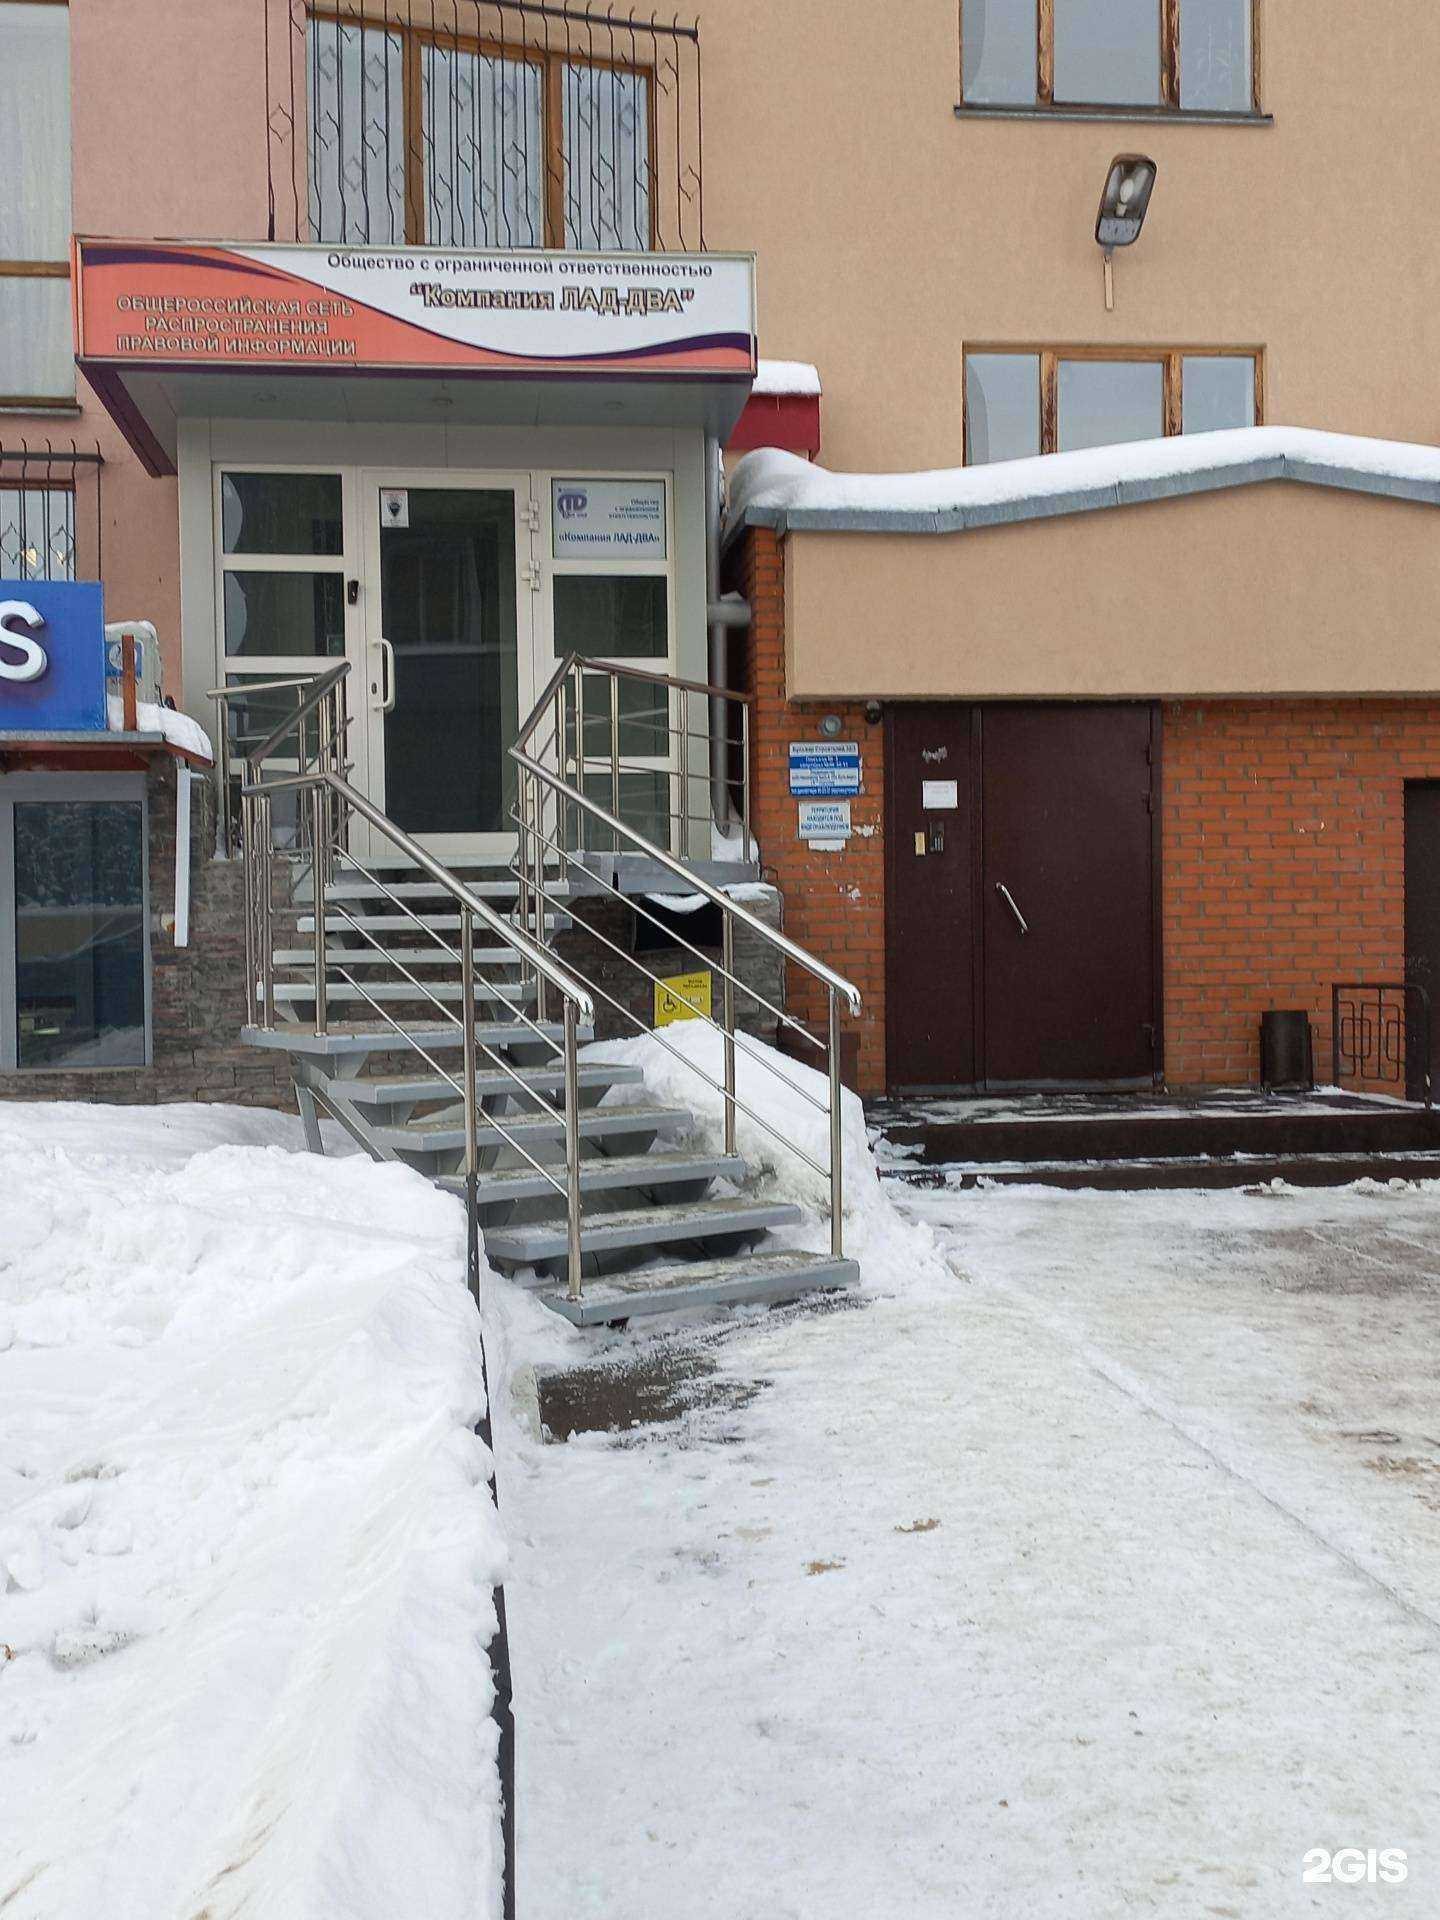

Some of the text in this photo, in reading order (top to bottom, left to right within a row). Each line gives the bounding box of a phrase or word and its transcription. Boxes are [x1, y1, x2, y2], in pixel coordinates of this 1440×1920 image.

[327, 252, 713, 278] Общество с ограниченной ответственностью
[117, 294, 355, 317] ОБЩЕРОССИЙСКАЯ СЕТЬ
[145, 316, 329, 336] РАСПРОСТРАНЕНИЯ
[117, 333, 357, 357] ПРАВОВОЙ ИНФОРМАЦИИ
[0, 600, 47, 683] S
